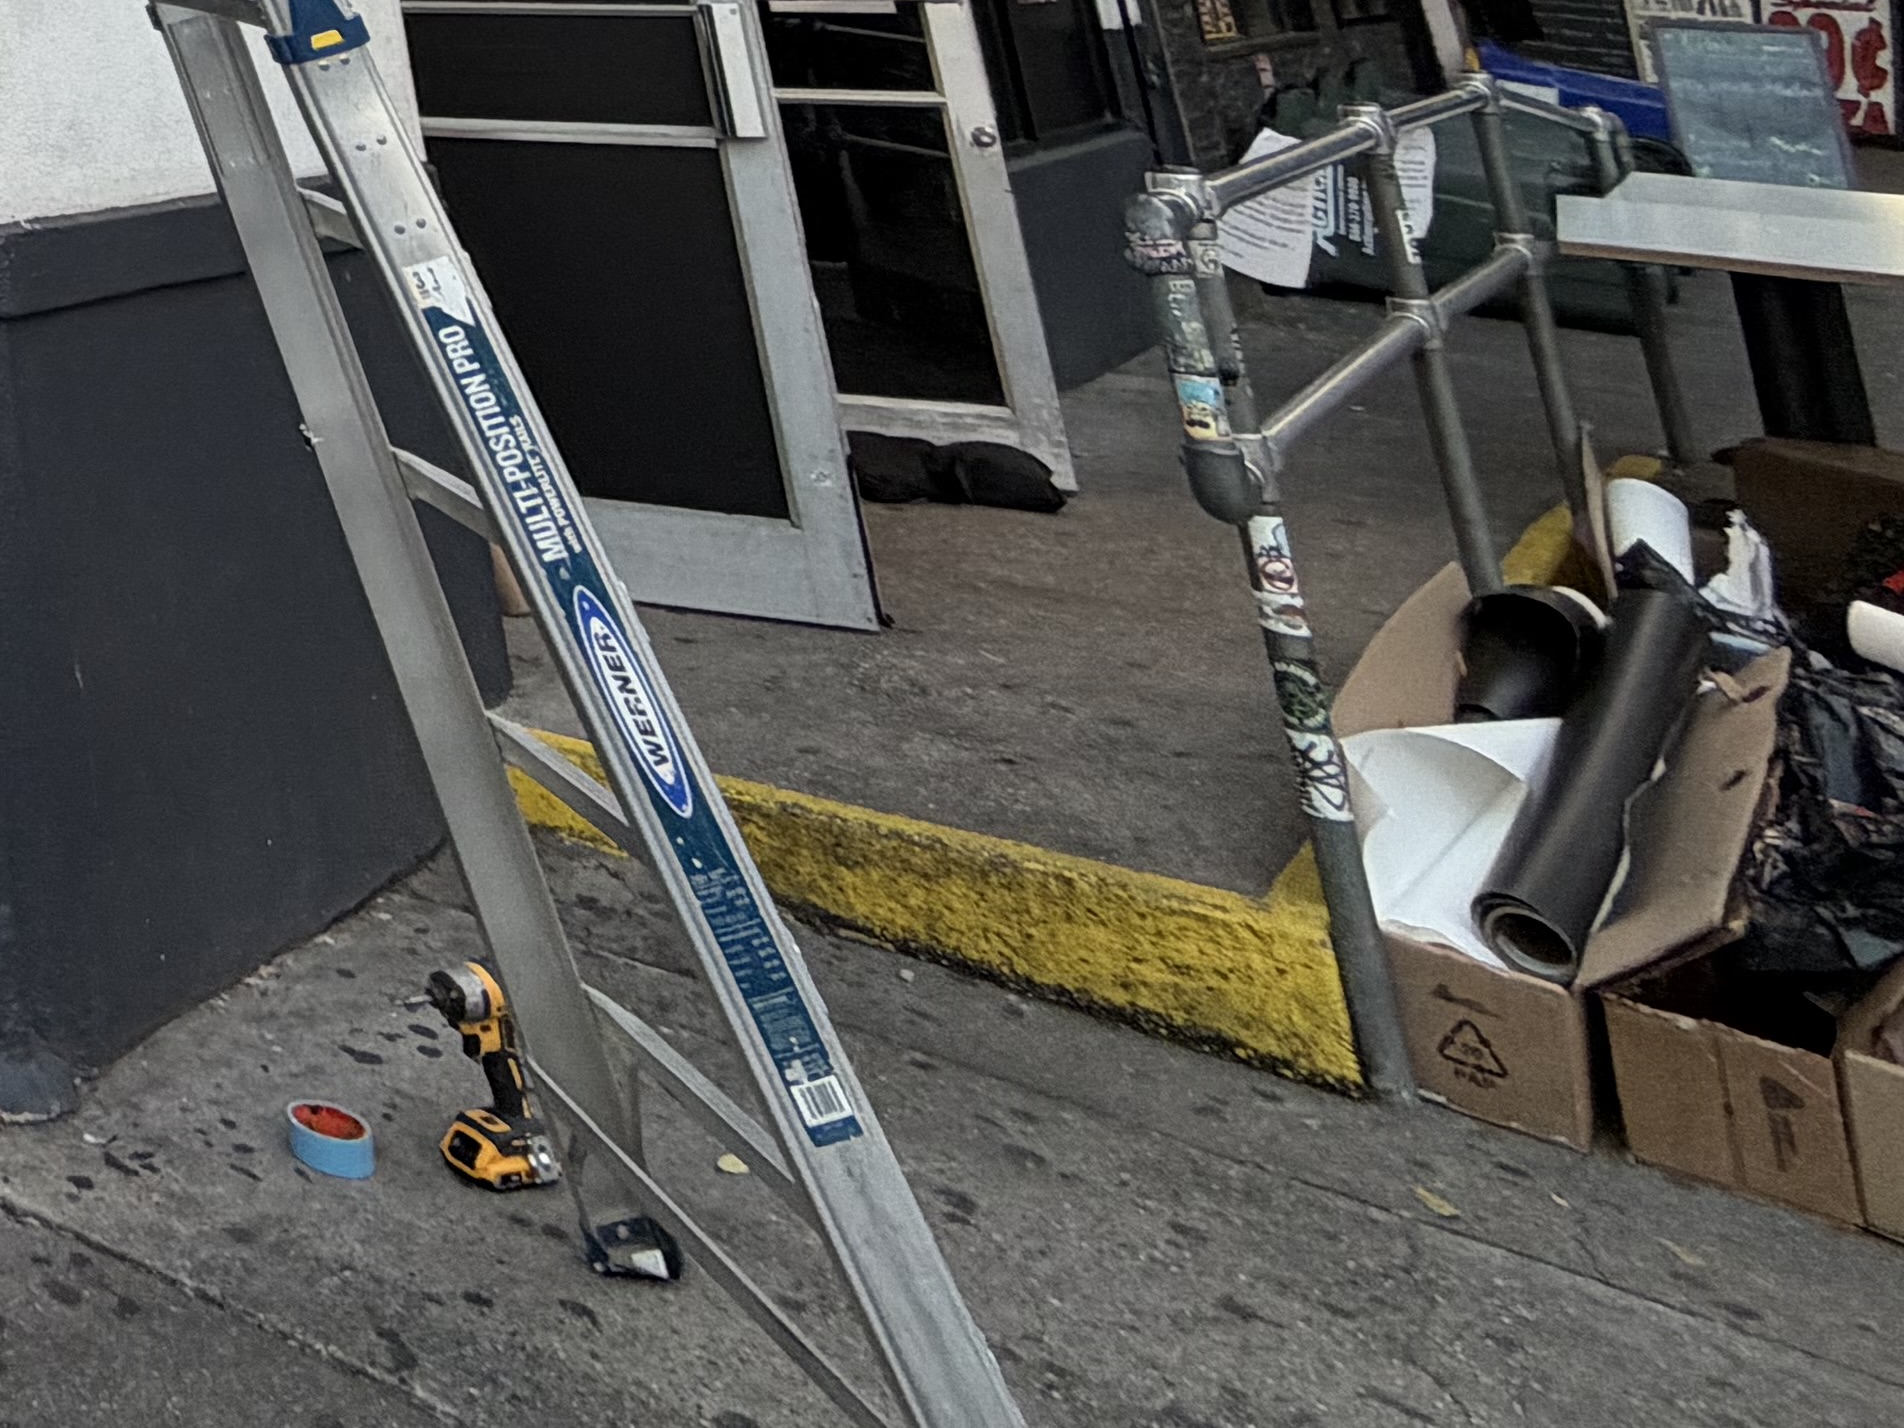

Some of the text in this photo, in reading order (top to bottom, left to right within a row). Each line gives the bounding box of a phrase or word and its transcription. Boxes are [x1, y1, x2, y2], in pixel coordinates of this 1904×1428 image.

[437, 323, 569, 563] MULTI-POSITION PRO
[592, 629, 671, 768] WERNER
